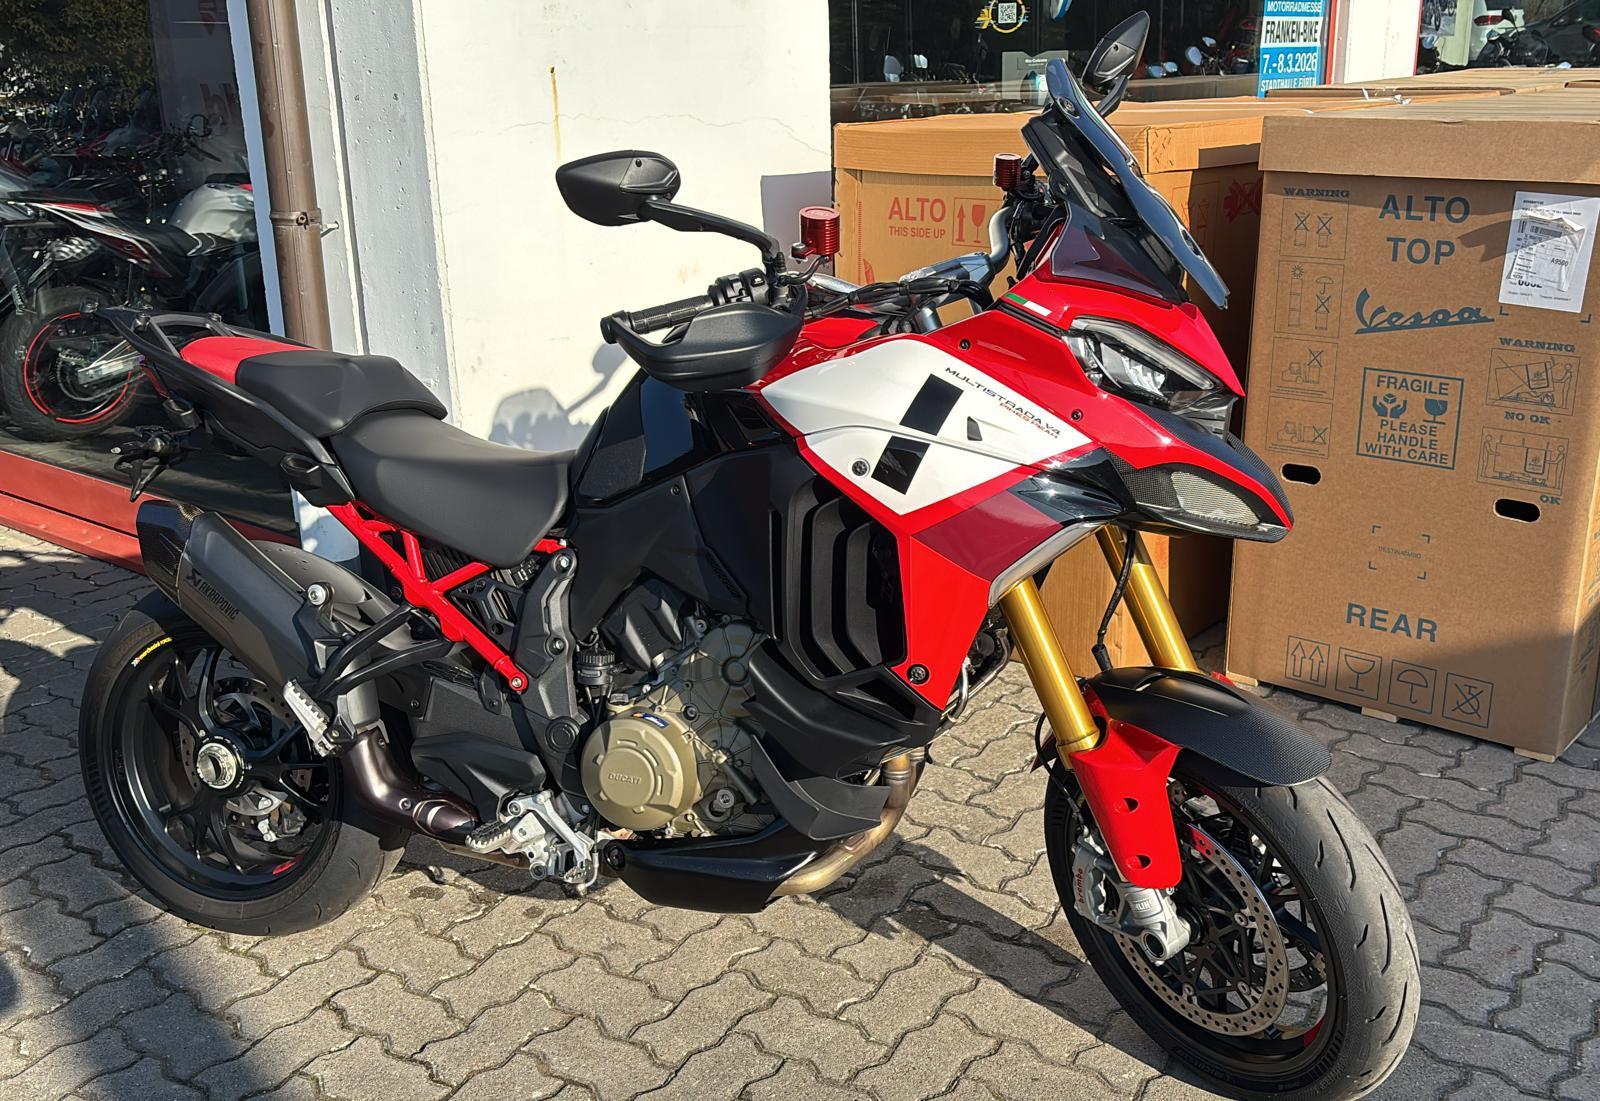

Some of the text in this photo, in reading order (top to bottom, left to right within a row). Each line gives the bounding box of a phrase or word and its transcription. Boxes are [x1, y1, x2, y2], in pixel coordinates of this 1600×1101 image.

[1267, 1, 1321, 12] MOTORRADMESSE
[1264, 21, 1318, 43] FRANKEN-BIKE
[1283, 187, 1350, 198] WARNING
[888, 197, 946, 223] ALTO
[1378, 194, 1470, 224] ALTO
[889, 226, 946, 240] THIS SIDE UP
[1386, 236, 1456, 265] TOP
[1355, 287, 1493, 334] Vespa
[1499, 337, 1576, 353] WARNING
[1376, 375, 1450, 396] FRAGILE
[945, 367, 1061, 436] MULTISTRADA V4
[1380, 419, 1438, 437] PLEASE
[1504, 411, 1552, 425] NO OK
[1377, 432, 1438, 451] HANDLE
[1365, 442, 1449, 465] WITH CARE
[1539, 495, 1561, 505] OK
[1346, 602, 1438, 643] REAR
[608, 773, 641, 785] DUCATI
[1076, 867, 1085, 904] brembo
